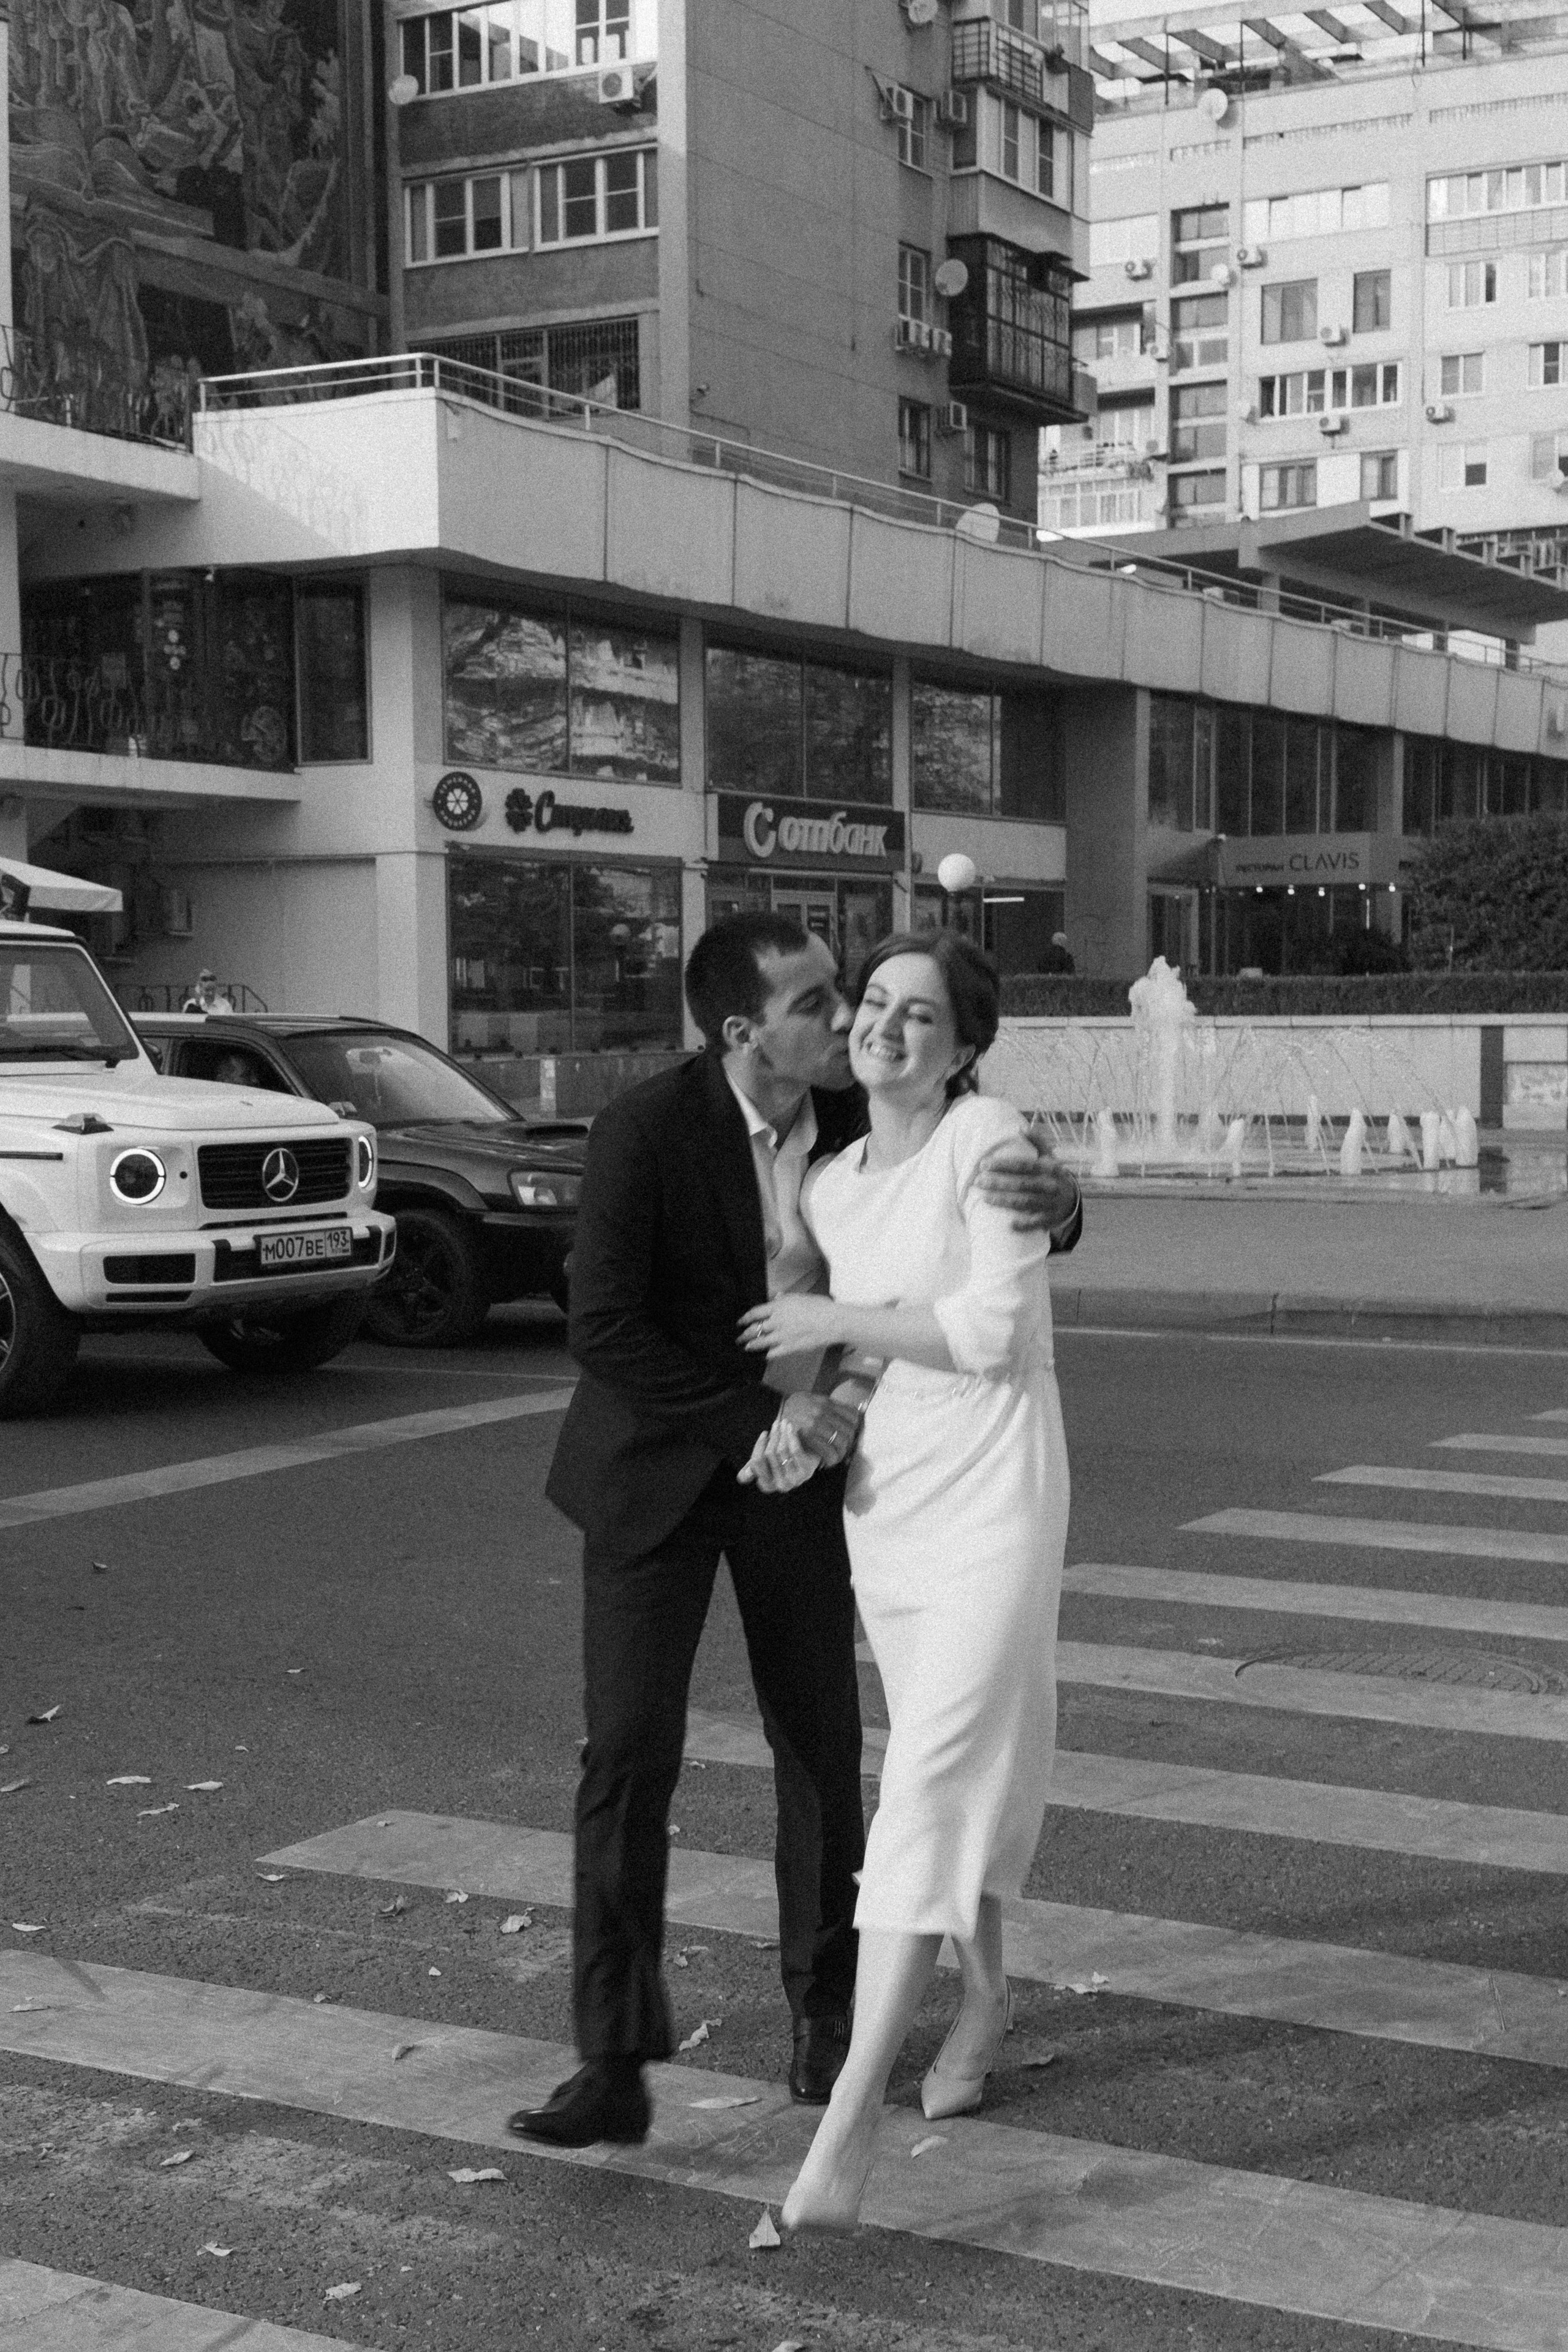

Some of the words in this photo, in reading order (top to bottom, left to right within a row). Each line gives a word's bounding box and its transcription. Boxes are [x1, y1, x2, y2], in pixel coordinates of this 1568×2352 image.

[1289, 852, 1360, 872] CLAVIS
[265, 1236, 323, 1261] М007ВЕ
[327, 1231, 348, 1248] 193
